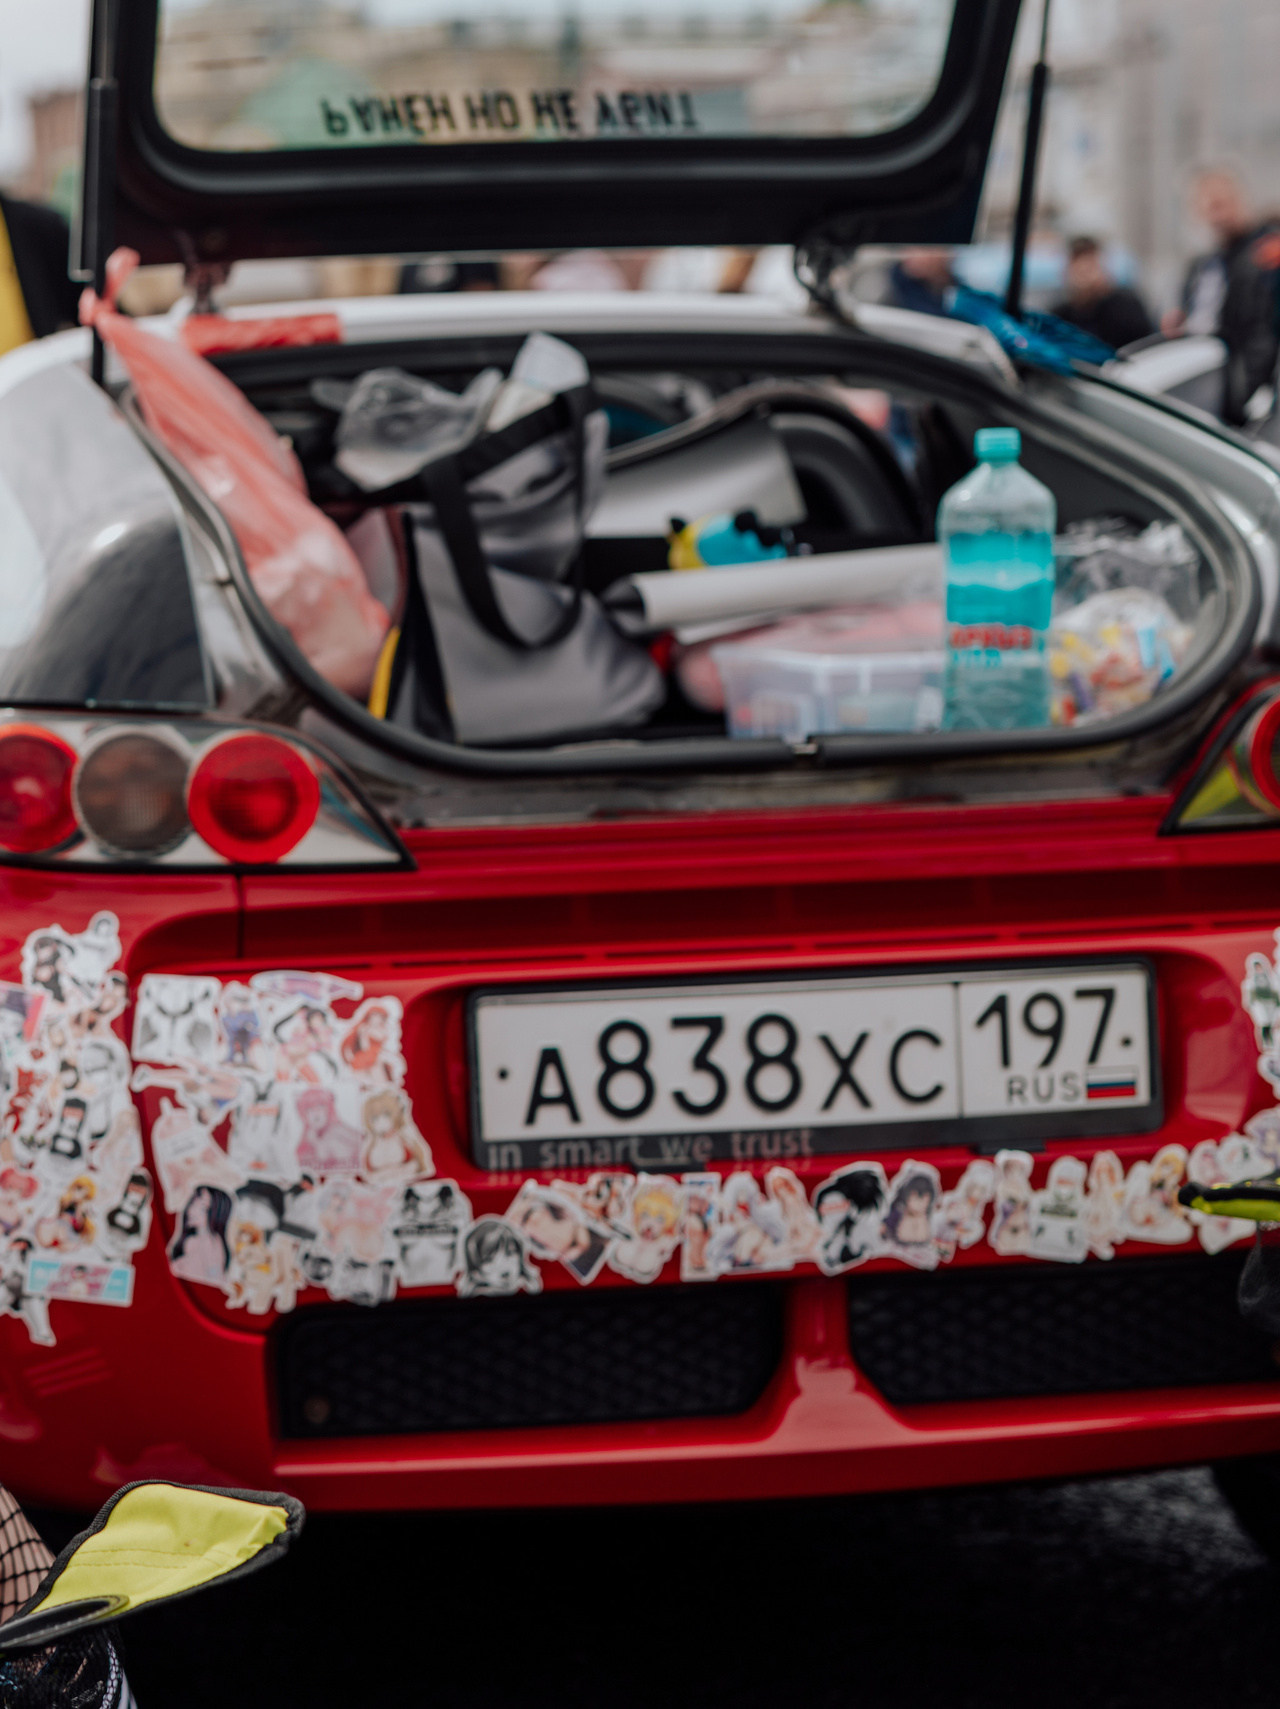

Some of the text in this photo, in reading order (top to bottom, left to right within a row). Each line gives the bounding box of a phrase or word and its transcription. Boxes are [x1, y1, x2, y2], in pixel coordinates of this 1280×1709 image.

[974, 987, 1116, 1069] 197
[1007, 1072, 1080, 1104] RUS
[487, 1127, 814, 1171] in smart we trust
